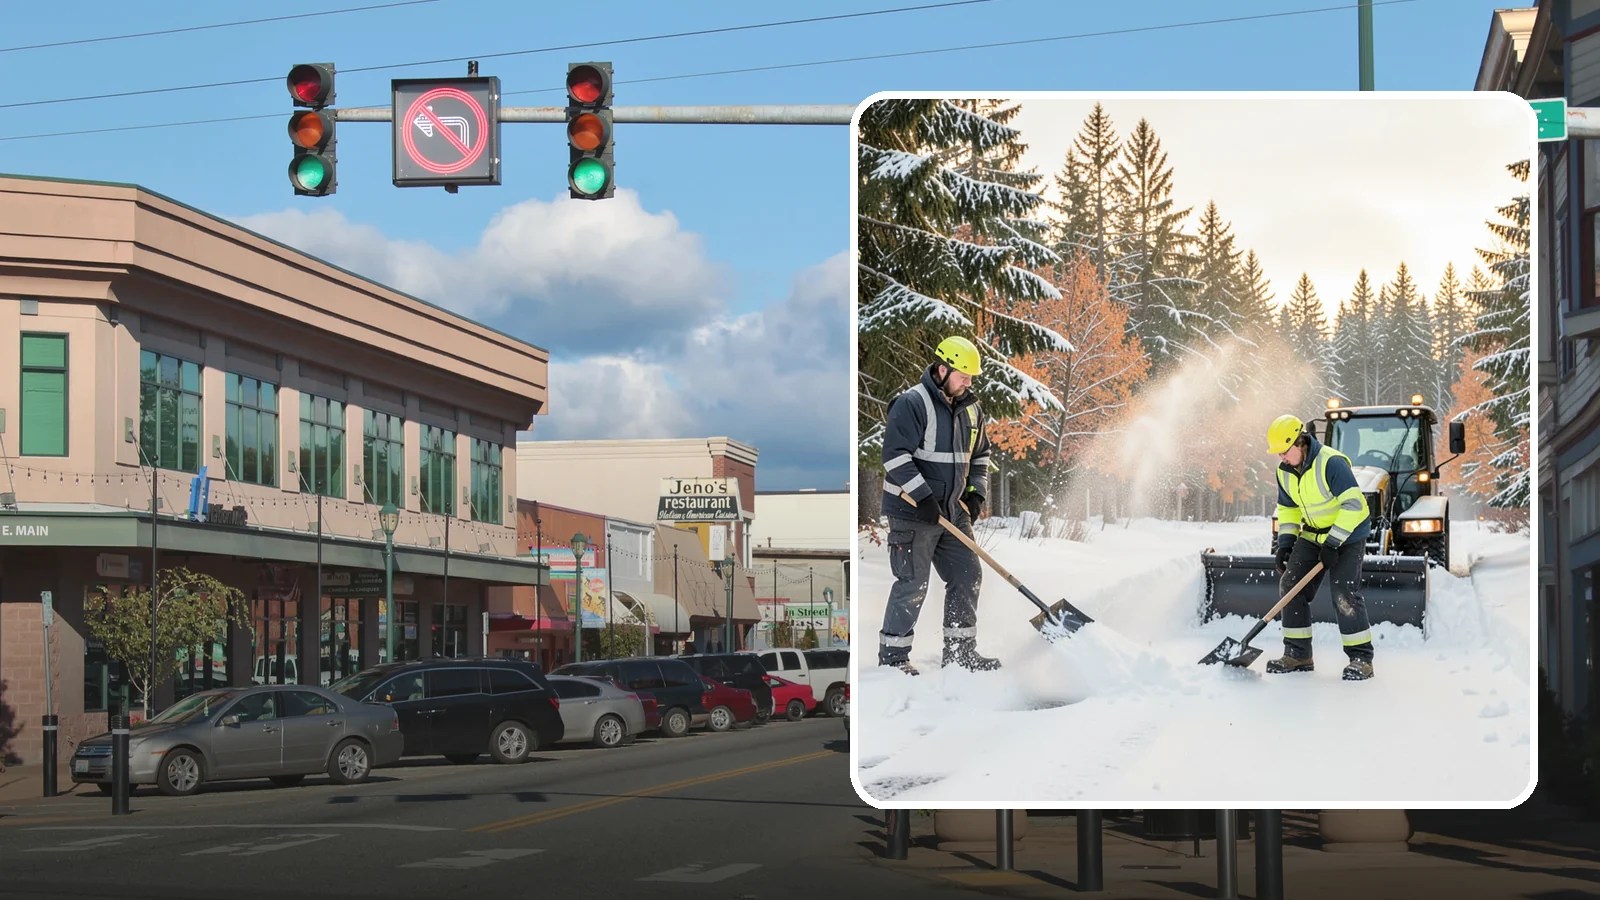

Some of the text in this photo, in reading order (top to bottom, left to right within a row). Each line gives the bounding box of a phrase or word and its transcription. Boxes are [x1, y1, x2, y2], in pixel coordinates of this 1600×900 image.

[670, 480, 727, 494] Jeno's
[665, 496, 731, 509] restaurant
[686, 509, 715, 519] American
[715, 509, 738, 519] Cuisine
[2, 525, 49, 536] E. MAIN
[797, 607, 828, 617] Street
[791, 619, 823, 627] lass
